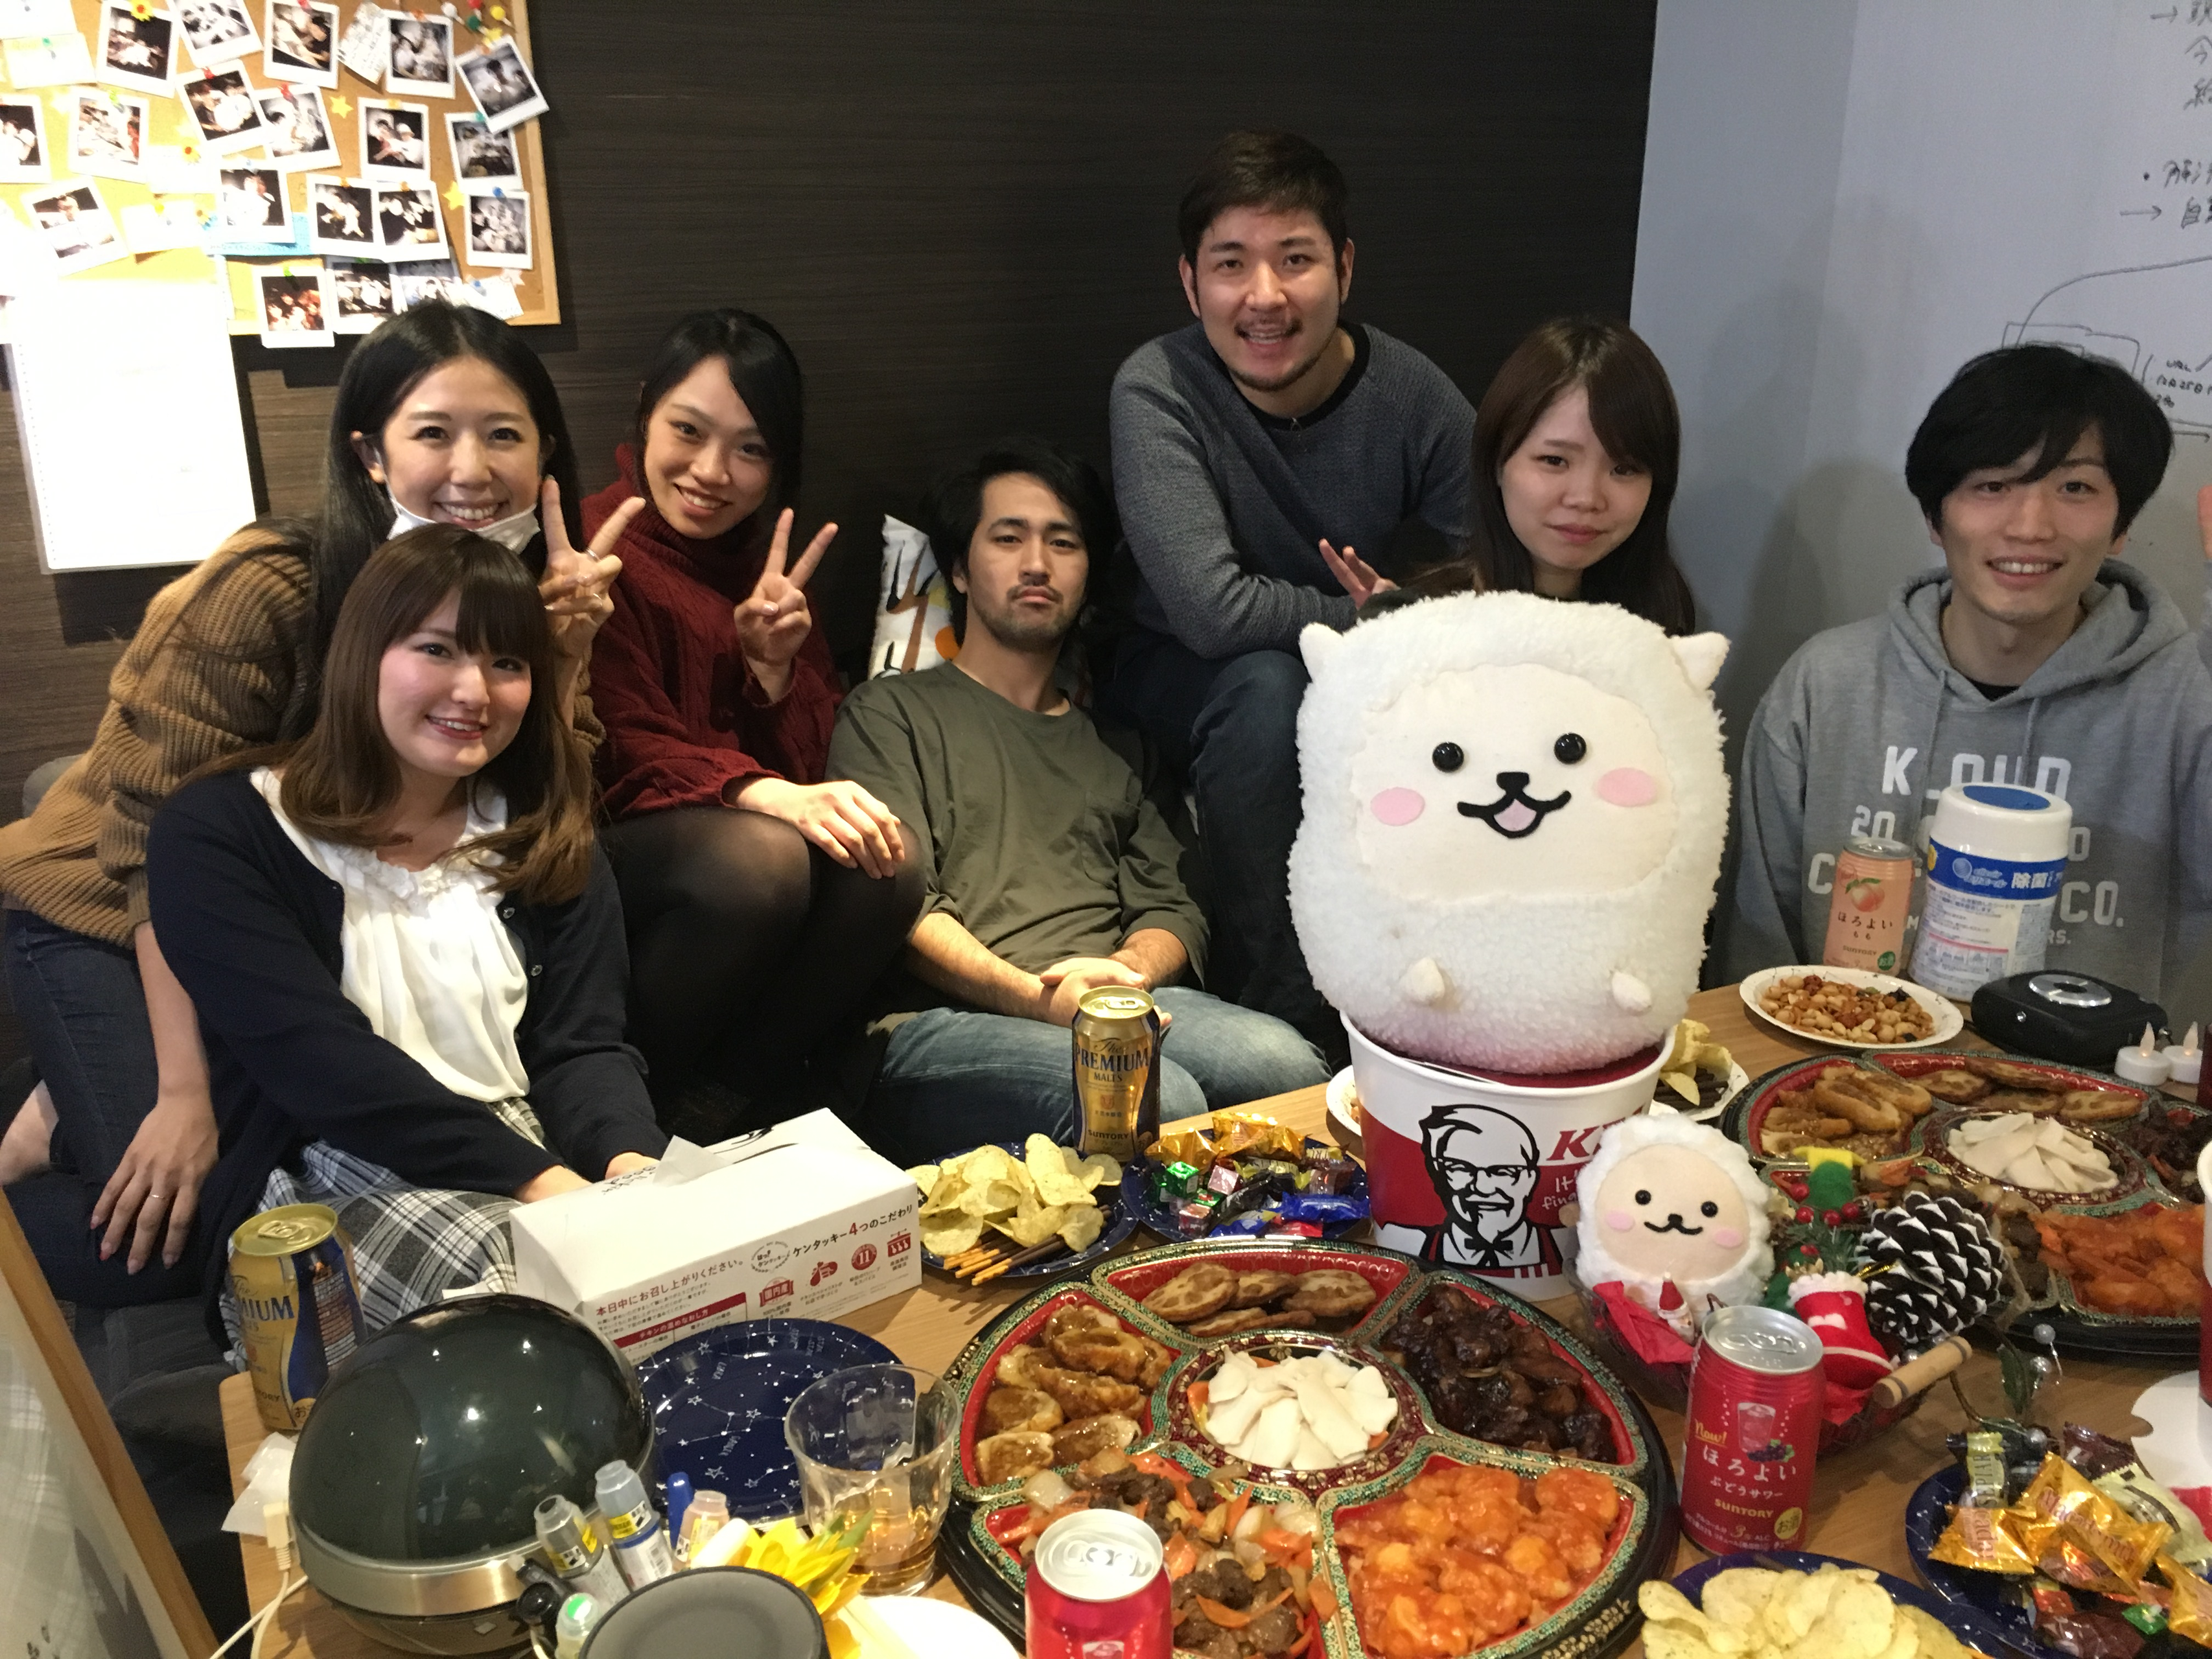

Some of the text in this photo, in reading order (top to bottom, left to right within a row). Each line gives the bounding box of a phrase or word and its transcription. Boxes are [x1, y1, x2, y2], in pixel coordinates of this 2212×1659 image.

[1837, 911, 1893, 930] ほろよい
[1075, 1042, 1149, 1072] PREMIUM
[1088, 1129, 1130, 1141] SUNTORY
[793, 1204, 913, 1257] ケンタッキー4つのこだわり
[596, 1260, 743, 1316] 本日中にお召し上がりください。
[1702, 1444, 1797, 1482] ほろよい
[1710, 1476, 1783, 1500] ぶどうサワー
[1714, 1498, 1774, 1519] SUNTORY
